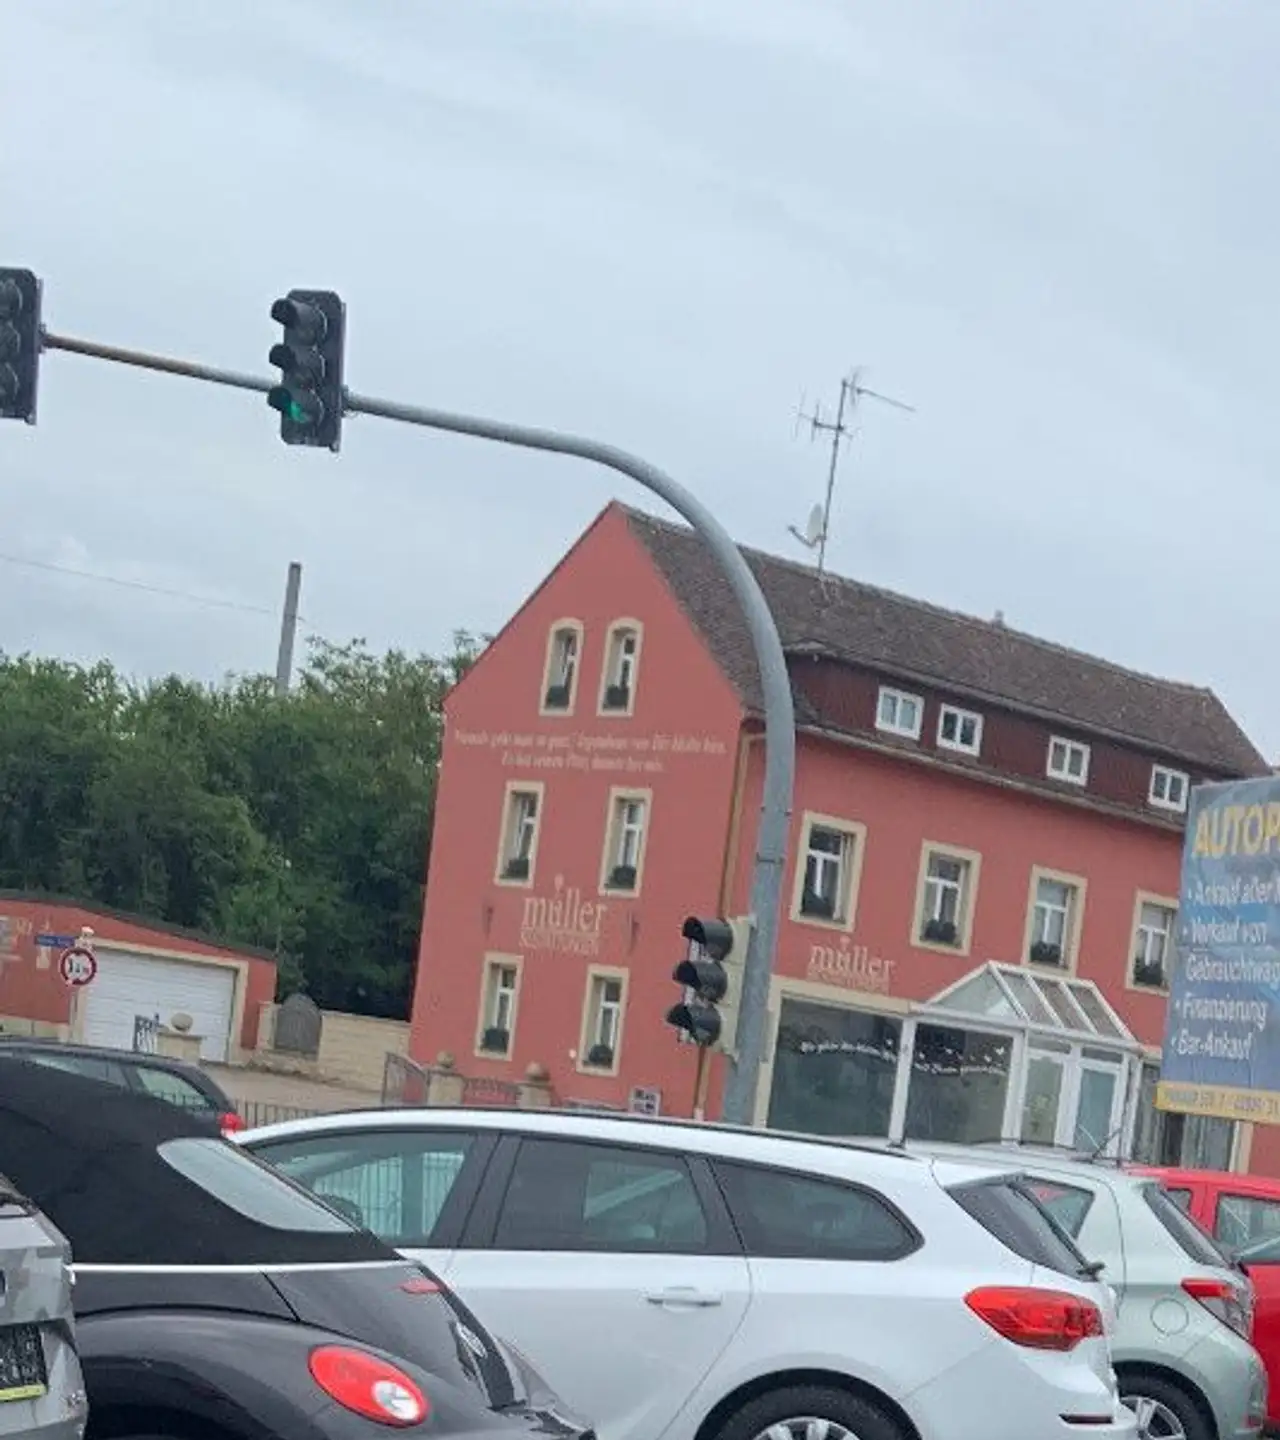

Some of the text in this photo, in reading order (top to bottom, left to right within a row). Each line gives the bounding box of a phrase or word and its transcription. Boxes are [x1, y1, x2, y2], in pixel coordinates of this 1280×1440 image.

[1242, 921, 1267, 943] von
[1182, 991, 1269, 1032] Finanzierung
[1178, 1028, 1253, 1060] Bar-Ankauf
